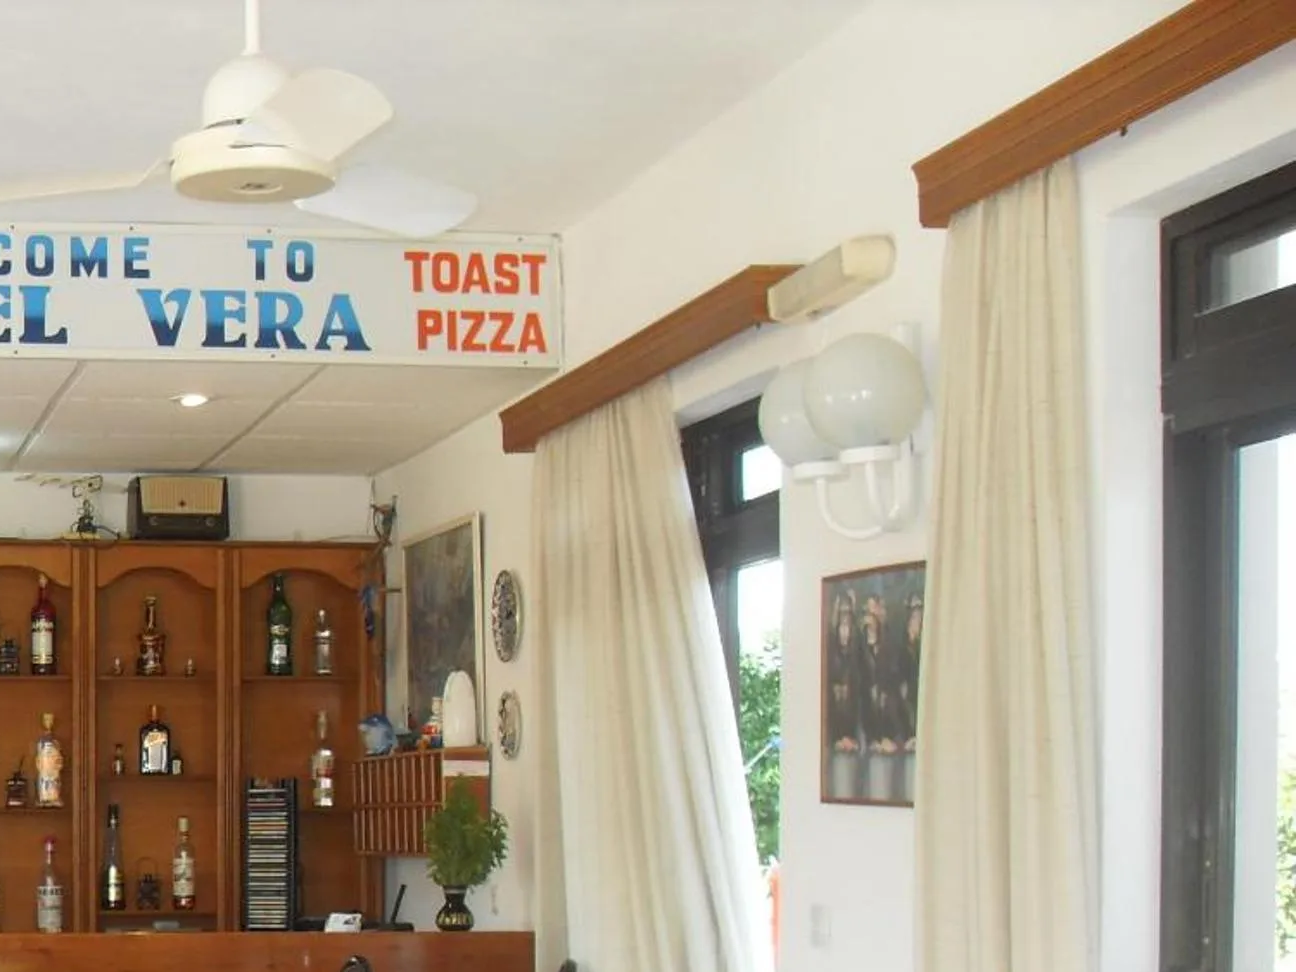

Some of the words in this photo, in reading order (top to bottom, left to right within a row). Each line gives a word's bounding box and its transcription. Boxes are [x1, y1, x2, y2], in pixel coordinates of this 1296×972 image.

[247, 239, 316, 283] TO
[404, 249, 547, 296] TOAST
[137, 287, 372, 352] VERA
[417, 308, 548, 354] PIZZA
